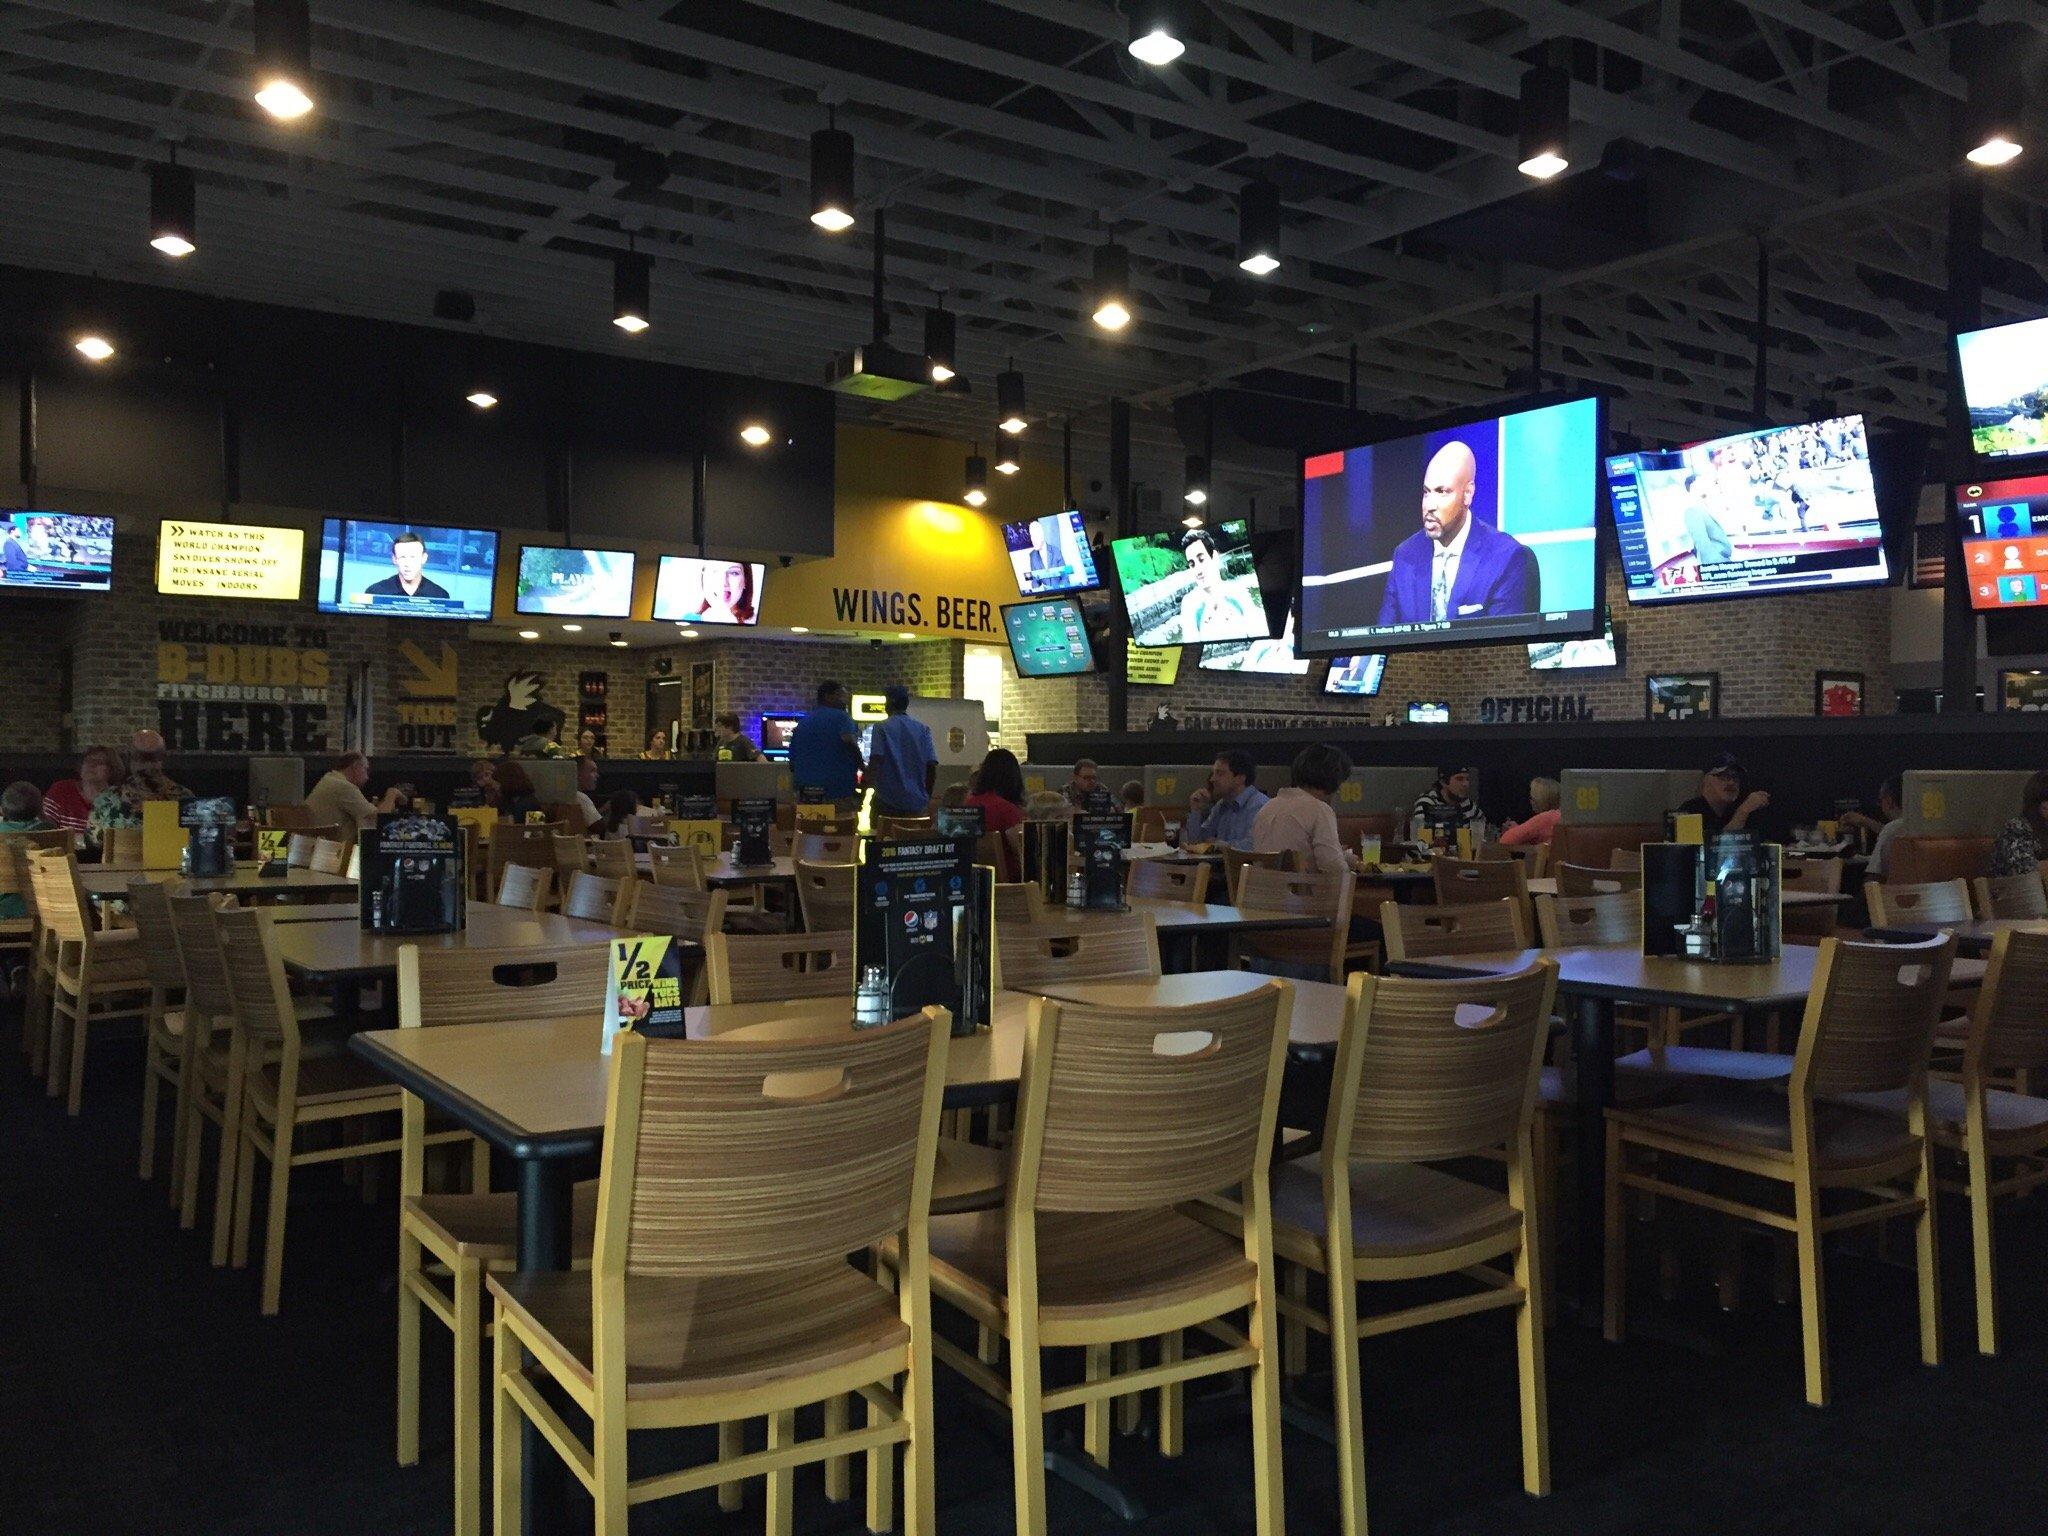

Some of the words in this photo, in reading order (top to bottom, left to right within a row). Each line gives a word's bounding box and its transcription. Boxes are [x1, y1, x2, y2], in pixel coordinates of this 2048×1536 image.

[1969, 514, 1982, 534] 1
[189, 529, 223, 538] WATCH
[228, 531, 239, 539] AS
[244, 532, 265, 540] THIS
[174, 541, 208, 549] WORLD
[211, 543, 260, 552] CHAMPION
[173, 554, 220, 562] SKYDIVER
[224, 557, 258, 565] SHOWS
[1974, 552, 1986, 564] 2
[193, 567, 228, 576] INSANE
[231, 569, 264, 578] AERIAL
[172, 579, 204, 587] MOVES
[217, 582, 258, 590] INDOORS
[1979, 586, 1990, 596] 3
[833, 587, 928, 627] WINGS.
[937, 595, 997, 633] BEER.
[159, 621, 287, 648] WELCOME
[292, 624, 327, 649] TO
[157, 643, 329, 686] B-DUBS
[302, 687, 328, 702] WI
[397, 704, 456, 726] TAKE
[1481, 695, 1594, 724] OFFICIAL
[159, 700, 327, 753] HERE
[398, 725, 456, 748] OUT
[897, 845, 922, 857] FANTASY
[924, 843, 944, 856] DRAFT
[618, 941, 651, 981] 1/2
[620, 979, 651, 991] PRICE
